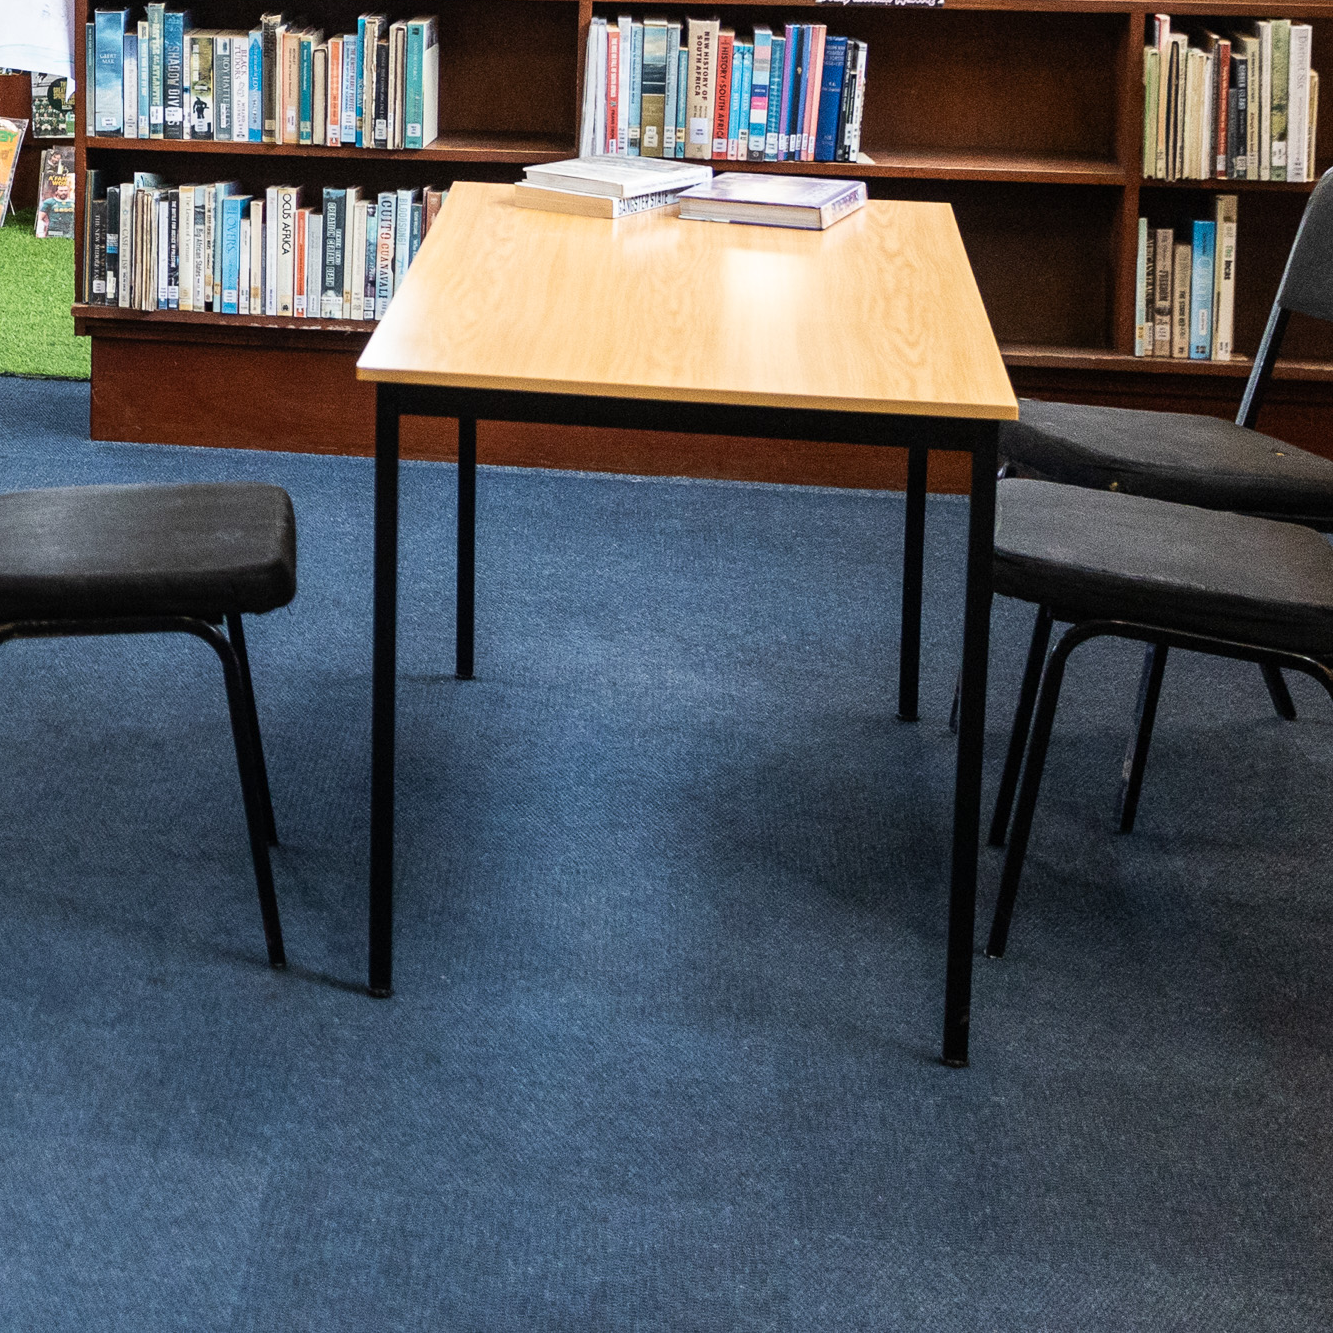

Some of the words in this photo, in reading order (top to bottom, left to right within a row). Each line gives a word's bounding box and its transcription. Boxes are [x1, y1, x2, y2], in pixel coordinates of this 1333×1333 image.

[151, 23, 161, 56] BATTLE
[695, 34, 703, 64] SOUTH
[702, 30, 711, 50] NEW
[1297, 35, 1307, 72] District
[167, 46, 179, 85] SHADOW
[222, 56, 230, 75] ROY
[234, 44, 242, 80] TUDORS
[240, 49, 248, 77] BLACK
[702, 51, 710, 88] HISTORY
[720, 46, 730, 81] HISTORY
[151, 64, 161, 106] ATLANTIC
[694, 65, 702, 97] AFRICA
[1296, 73, 1306, 90] Six
[701, 89, 708, 102] OF
[717, 82, 727, 112] SOUTH
[184, 195, 192, 208] The
[618, 193, 650, 216] GANGSTER
[651, 191, 669, 206] STATE
[194, 227, 204, 237] Big
[326, 201, 336, 238] OPERATION
[381, 200, 392, 240] CUITO
[398, 198, 408, 245] BLOODSONG!
[121, 228, 130, 248] CASE
[184, 237, 192, 263] Vietnam
[194, 237, 204, 260] African
[281, 221, 292, 256] AFRICA
[326, 238, 336, 266] CERTAIN
[194, 259, 204, 278] States
[325, 266, 335, 287] DEATH
[1223, 259, 1234, 281] Incas
